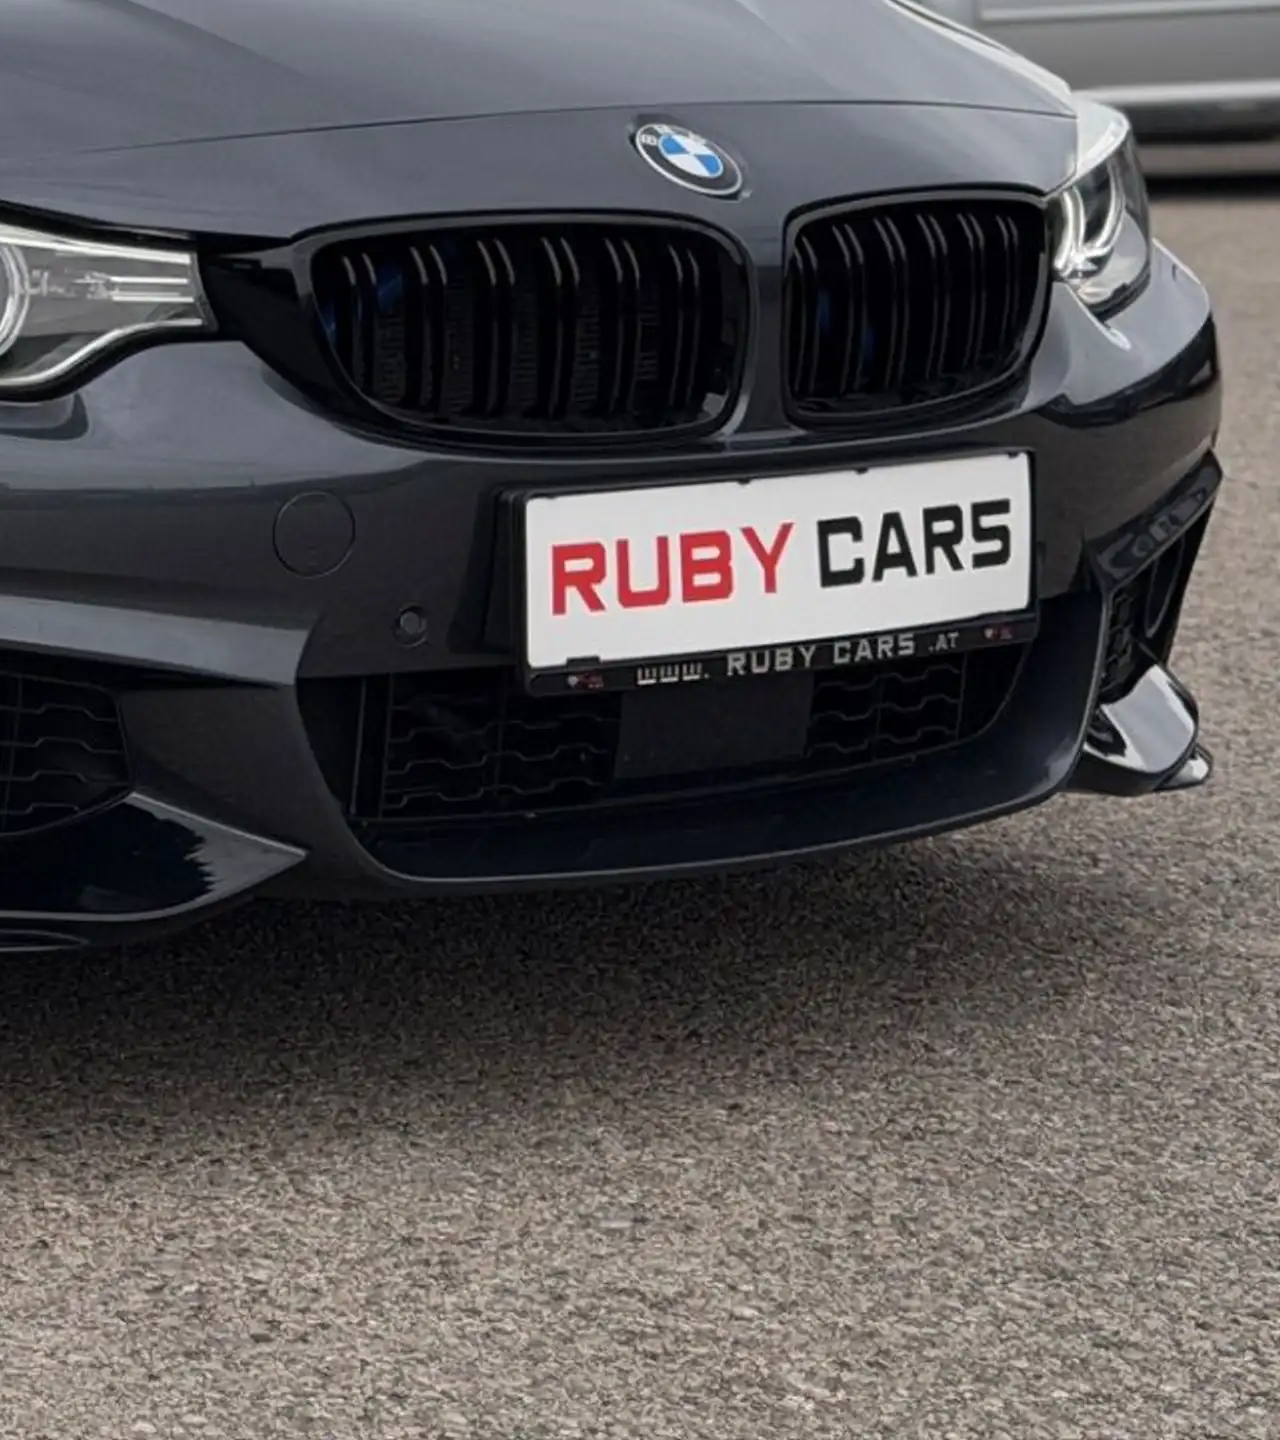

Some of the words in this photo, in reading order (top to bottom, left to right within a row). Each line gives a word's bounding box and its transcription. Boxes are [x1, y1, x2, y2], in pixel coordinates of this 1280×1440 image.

[550, 521, 795, 616] RUBY
[817, 497, 1012, 589] CARS
[726, 643, 817, 677] RUBY
[833, 632, 916, 665] CARS
